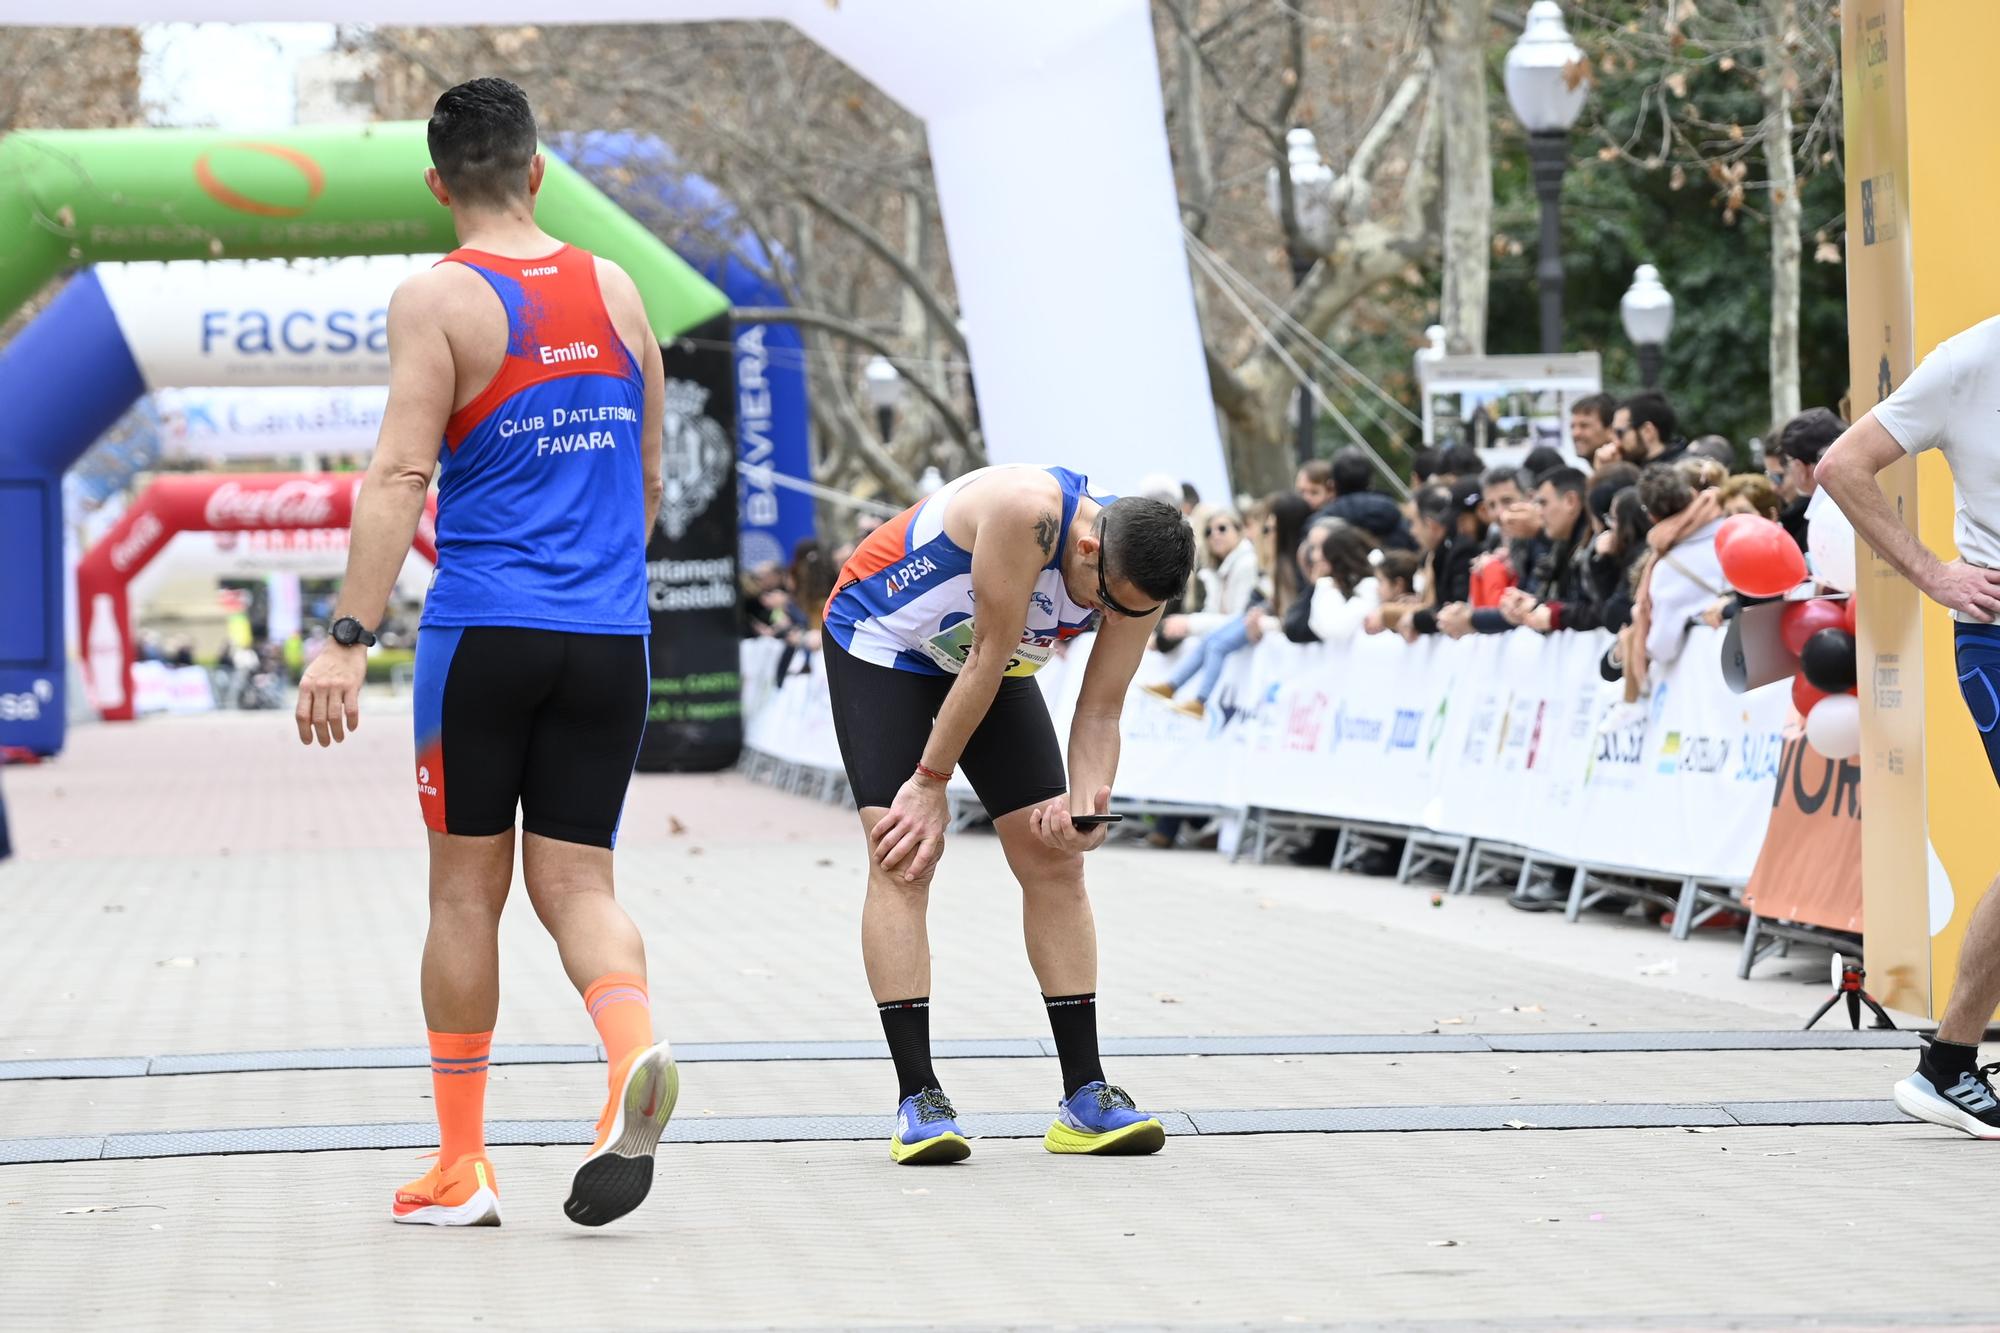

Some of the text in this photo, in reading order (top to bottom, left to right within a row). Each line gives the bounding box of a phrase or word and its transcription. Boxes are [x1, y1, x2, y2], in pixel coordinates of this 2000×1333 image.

[521, 265, 559, 277] VIATOR
[539, 340, 599, 365] Emilio
[736, 323, 779, 527] BAVIERA
[536, 430, 616, 457] FAVARA
[886, 555, 938, 598] ALPESA
[417, 784, 438, 797] IATOR
